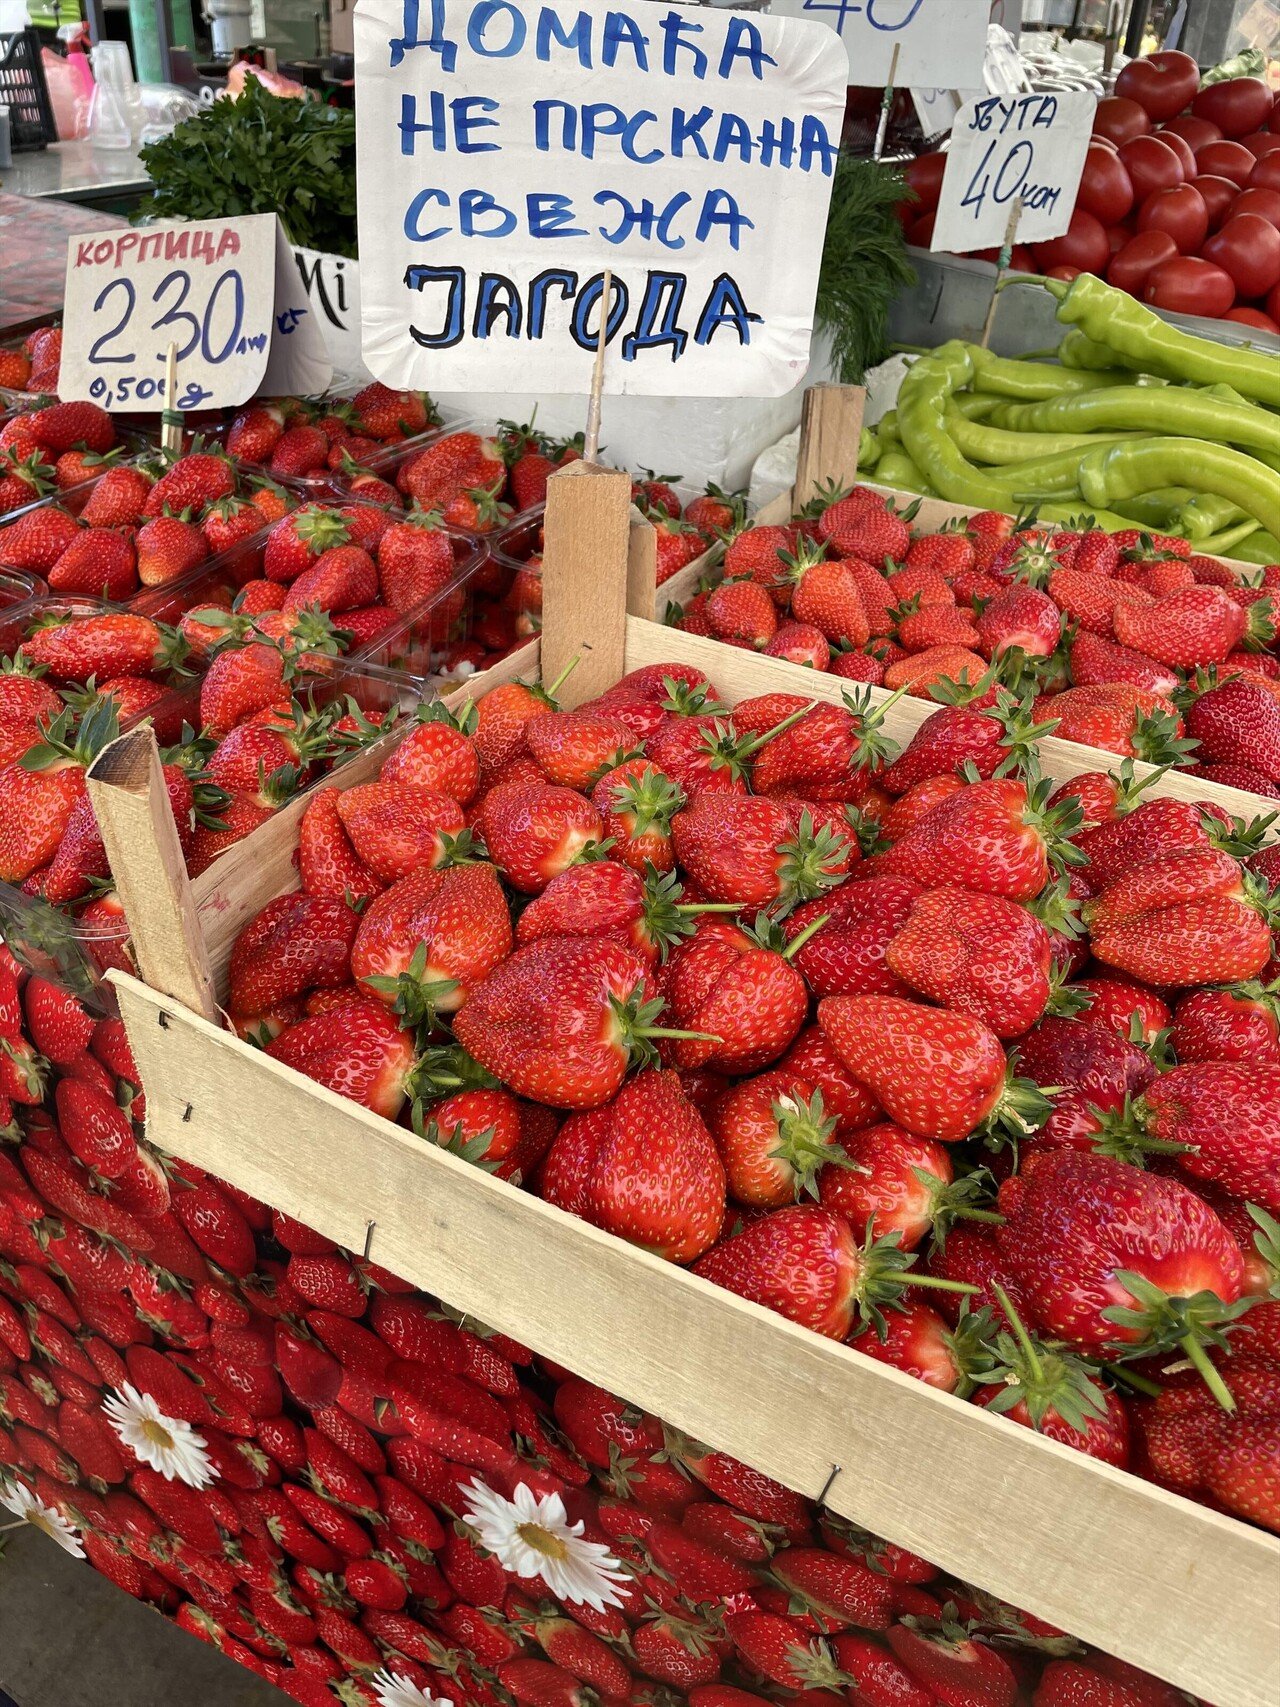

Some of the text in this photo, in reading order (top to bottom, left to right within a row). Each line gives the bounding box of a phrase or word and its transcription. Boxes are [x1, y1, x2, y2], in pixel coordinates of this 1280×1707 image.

[389, 0, 778, 81] ДОМАЋА
[397, 91, 839, 177] НЕ ПРСКАНА
[404, 188, 755, 251] СВЕЖА
[961, 139, 1033, 219] 40
[75, 228, 240, 268] КОРПИЦА
[88, 269, 245, 364] 230
[403, 264, 765, 362] ЈАГОДА
